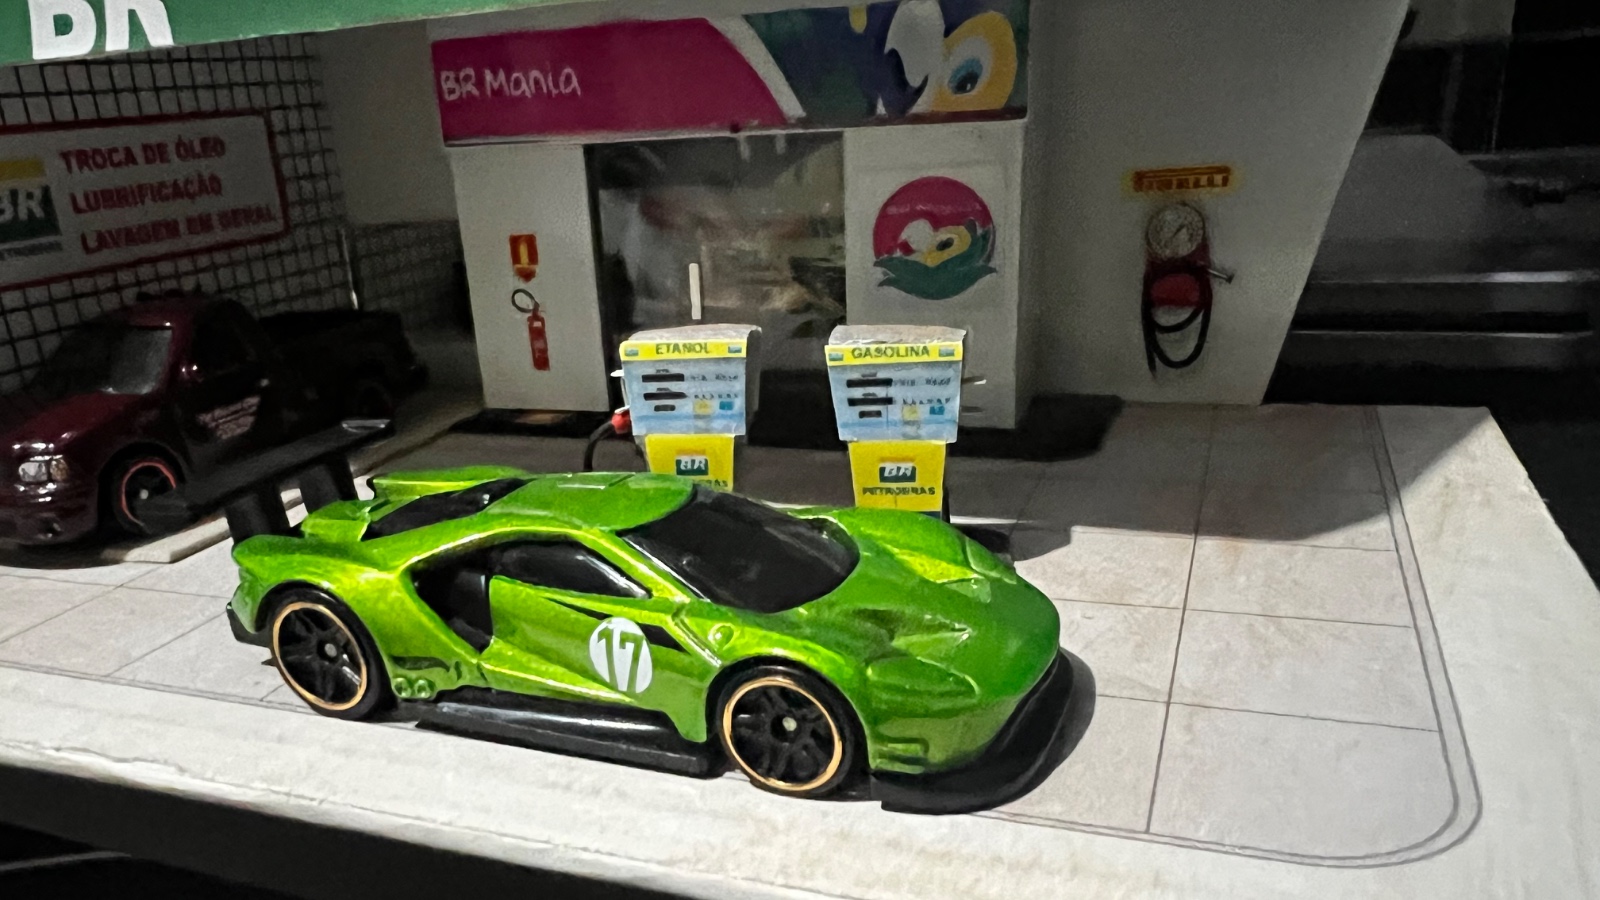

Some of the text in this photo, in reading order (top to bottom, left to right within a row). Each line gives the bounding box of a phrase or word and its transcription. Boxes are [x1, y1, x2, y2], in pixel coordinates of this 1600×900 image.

[441, 67, 582, 101] BR Mania
[60, 134, 226, 174] TROCA DE ÓLEO
[655, 342, 710, 355] ETANOL
[851, 345, 930, 359] GASOLINA
[680, 458, 706, 471] BR
[597, 625, 645, 692] 17
